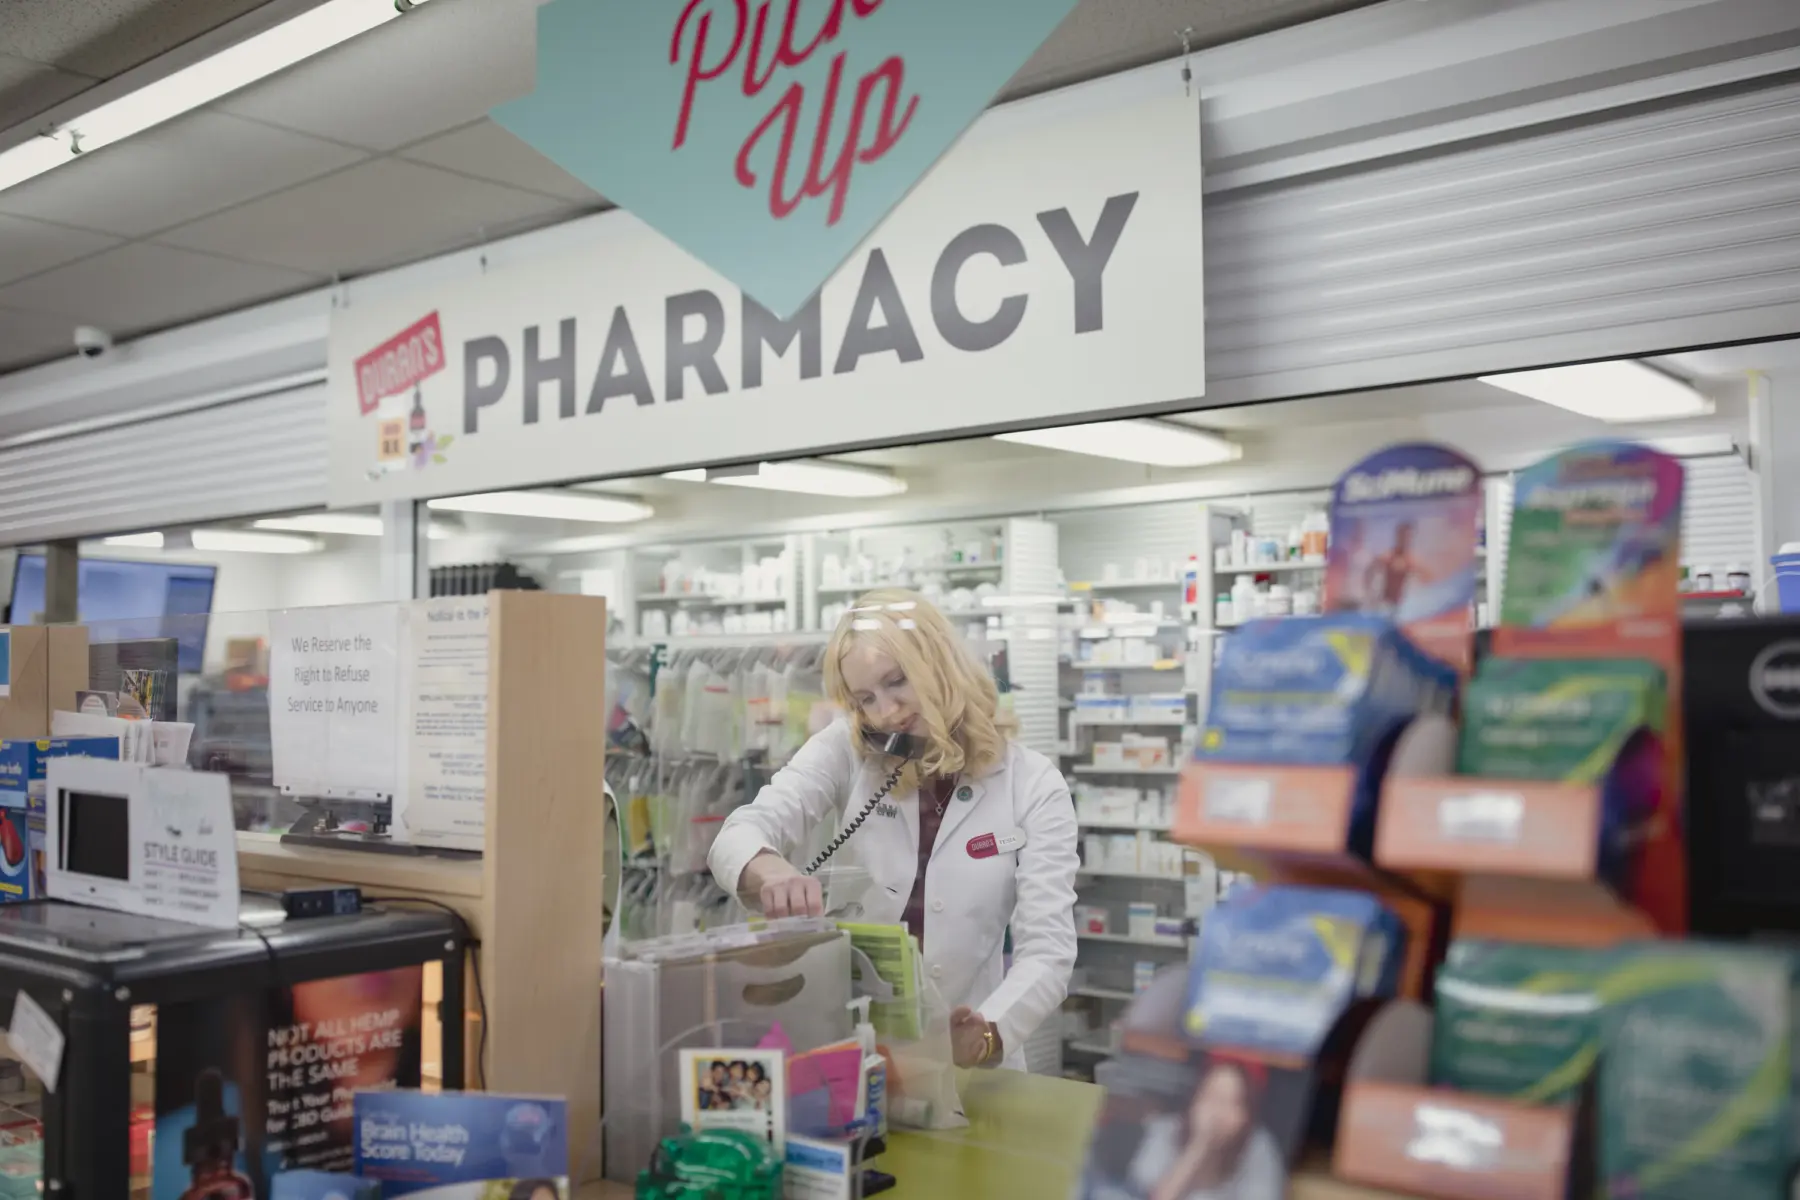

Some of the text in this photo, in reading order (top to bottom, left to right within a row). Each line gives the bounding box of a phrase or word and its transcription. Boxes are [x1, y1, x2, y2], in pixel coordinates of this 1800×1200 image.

[669, 0, 885, 153] Pic
[734, 49, 921, 229] Up
[463, 190, 1141, 435] PHARMACY
[291, 634, 372, 653] We Reserve the
[294, 665, 370, 686] Right to Refuse
[287, 696, 379, 716] Service to Anyone
[144, 841, 218, 868] STYLE GUIDE
[267, 1008, 400, 1047] NOT ALL HEMP
[267, 1029, 403, 1069] PRODUCTS ARE
[266, 1067, 304, 1091] THE
[307, 1057, 359, 1085] SAME
[361, 1117, 470, 1145] Brain Health
[361, 1140, 411, 1160] Score
[413, 1142, 467, 1168] Today
